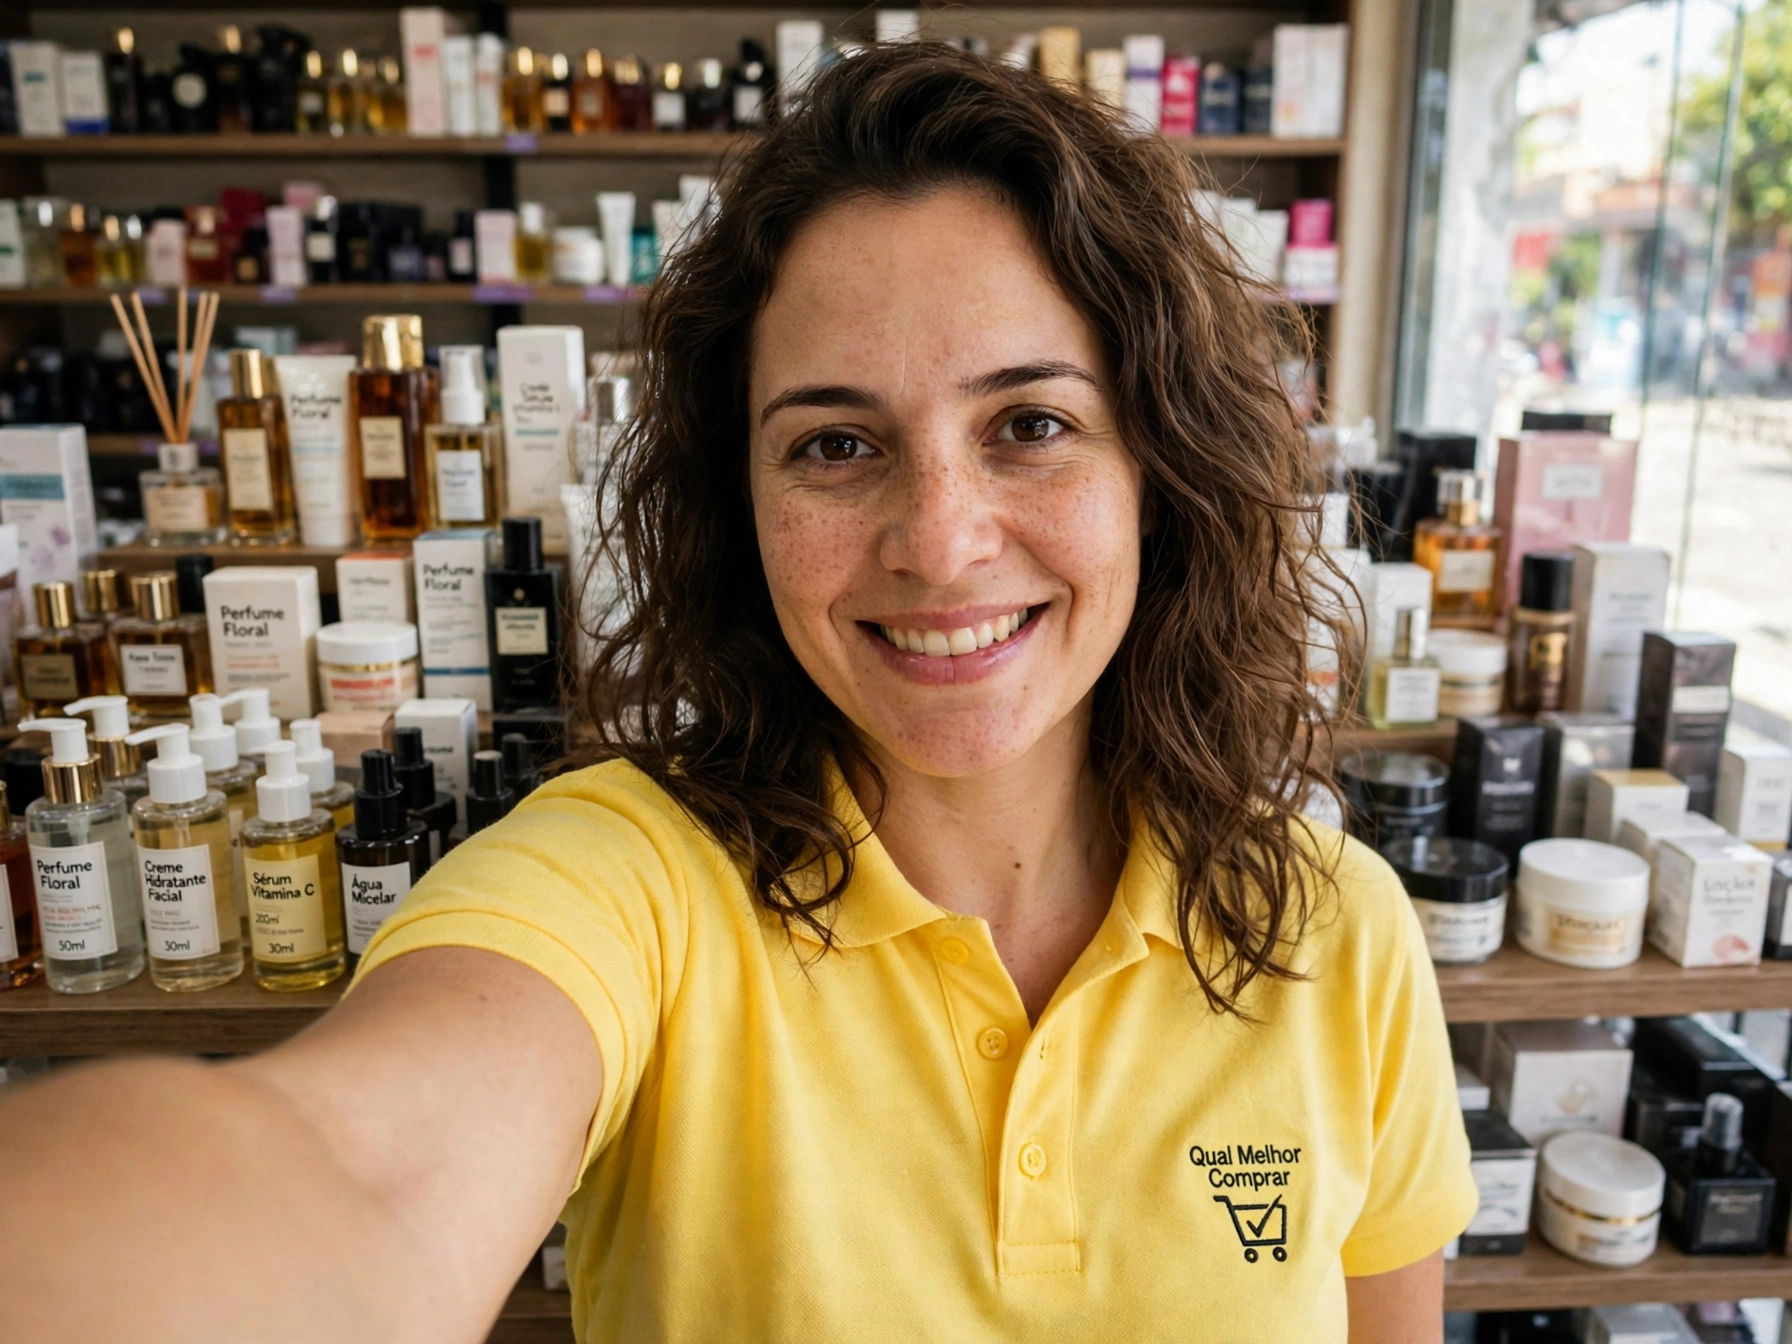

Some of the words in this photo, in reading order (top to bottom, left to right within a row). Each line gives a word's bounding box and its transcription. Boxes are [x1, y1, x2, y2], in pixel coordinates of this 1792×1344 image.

[423, 563, 475, 576] Perfume
[424, 578, 461, 591] Floral
[221, 605, 285, 620] Perfume
[223, 622, 269, 637] Floral
[37, 860, 93, 874] Perfume
[145, 860, 184, 873] Creme
[41, 875, 81, 889] Floral
[145, 873, 207, 888] Hidratante
[253, 872, 292, 885] Sérum
[351, 873, 383, 893] Água
[148, 888, 183, 902] Facial
[250, 884, 302, 900] Vitamina
[304, 883, 315, 896] C
[352, 891, 397, 905] Micelar
[58, 940, 86, 951] 50ml
[268, 942, 295, 954] 30ml
[1189, 1145, 1233, 1167] Qual
[1237, 1144, 1302, 1165] Melhor
[1208, 1167, 1290, 1191] Comprar
